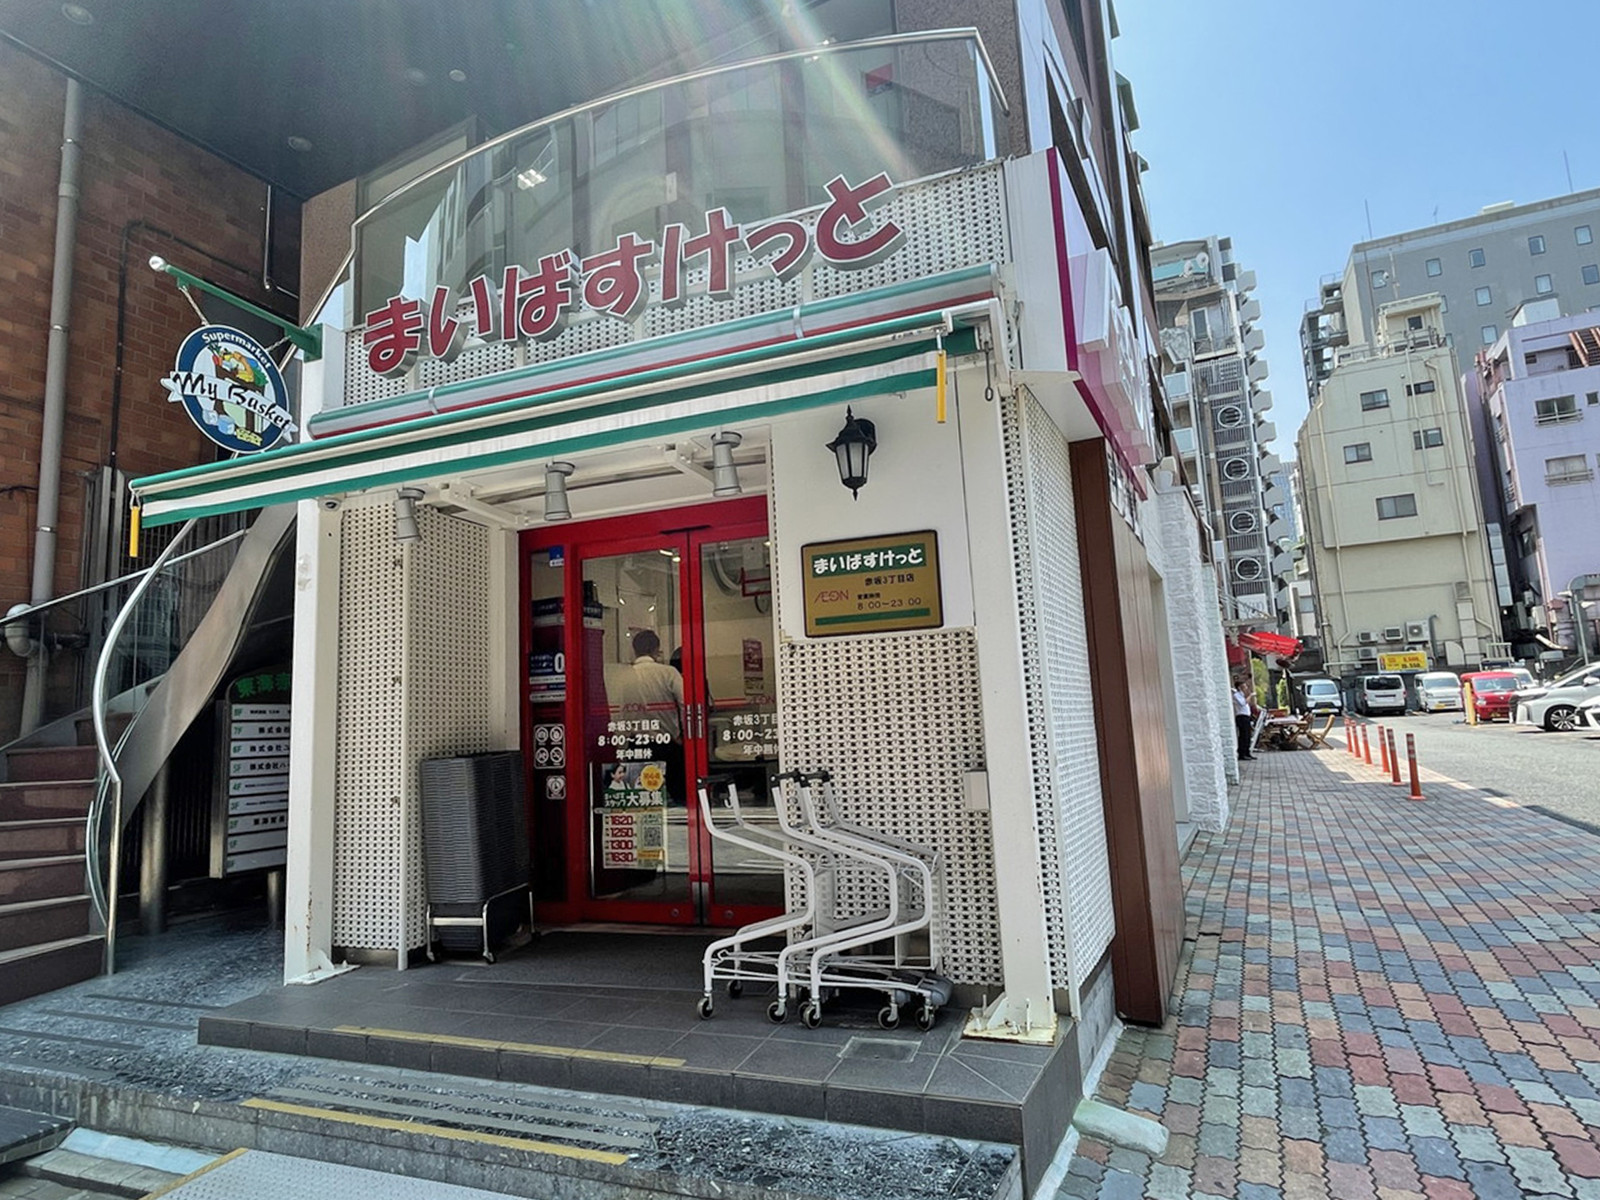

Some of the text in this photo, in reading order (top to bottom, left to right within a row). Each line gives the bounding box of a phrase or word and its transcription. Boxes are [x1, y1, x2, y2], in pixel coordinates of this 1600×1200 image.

[362, 171, 903, 376] まいばすけっと
[202, 332, 272, 369] Supermarket
[173, 372, 293, 430] My Basket
[813, 547, 923, 574] まいばすけっと
[615, 747, 653, 760] 年中無休
[626, 790, 664, 807] 大募集
